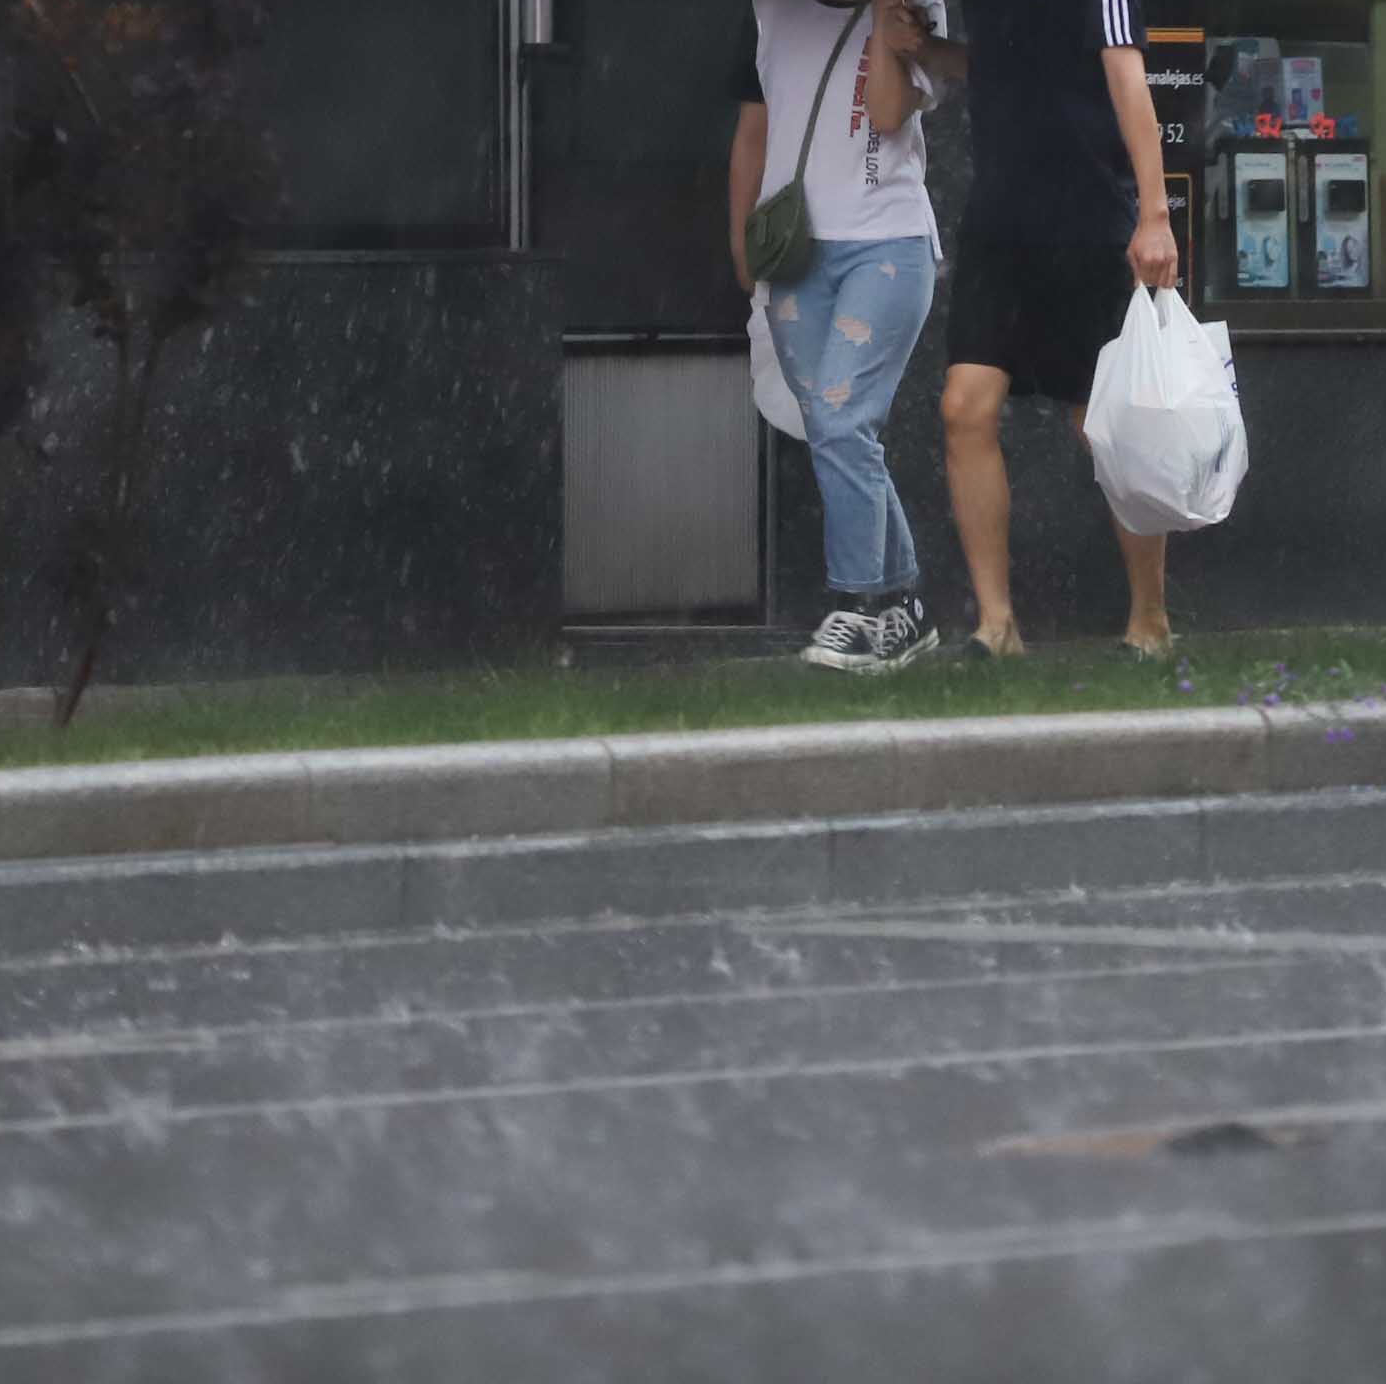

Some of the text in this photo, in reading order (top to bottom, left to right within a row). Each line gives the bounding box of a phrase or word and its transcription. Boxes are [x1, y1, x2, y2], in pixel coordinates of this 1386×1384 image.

[1146, 68, 1205, 91] analejas.es
[1165, 123, 1185, 144] 52
[865, 156, 879, 185] LOVE
